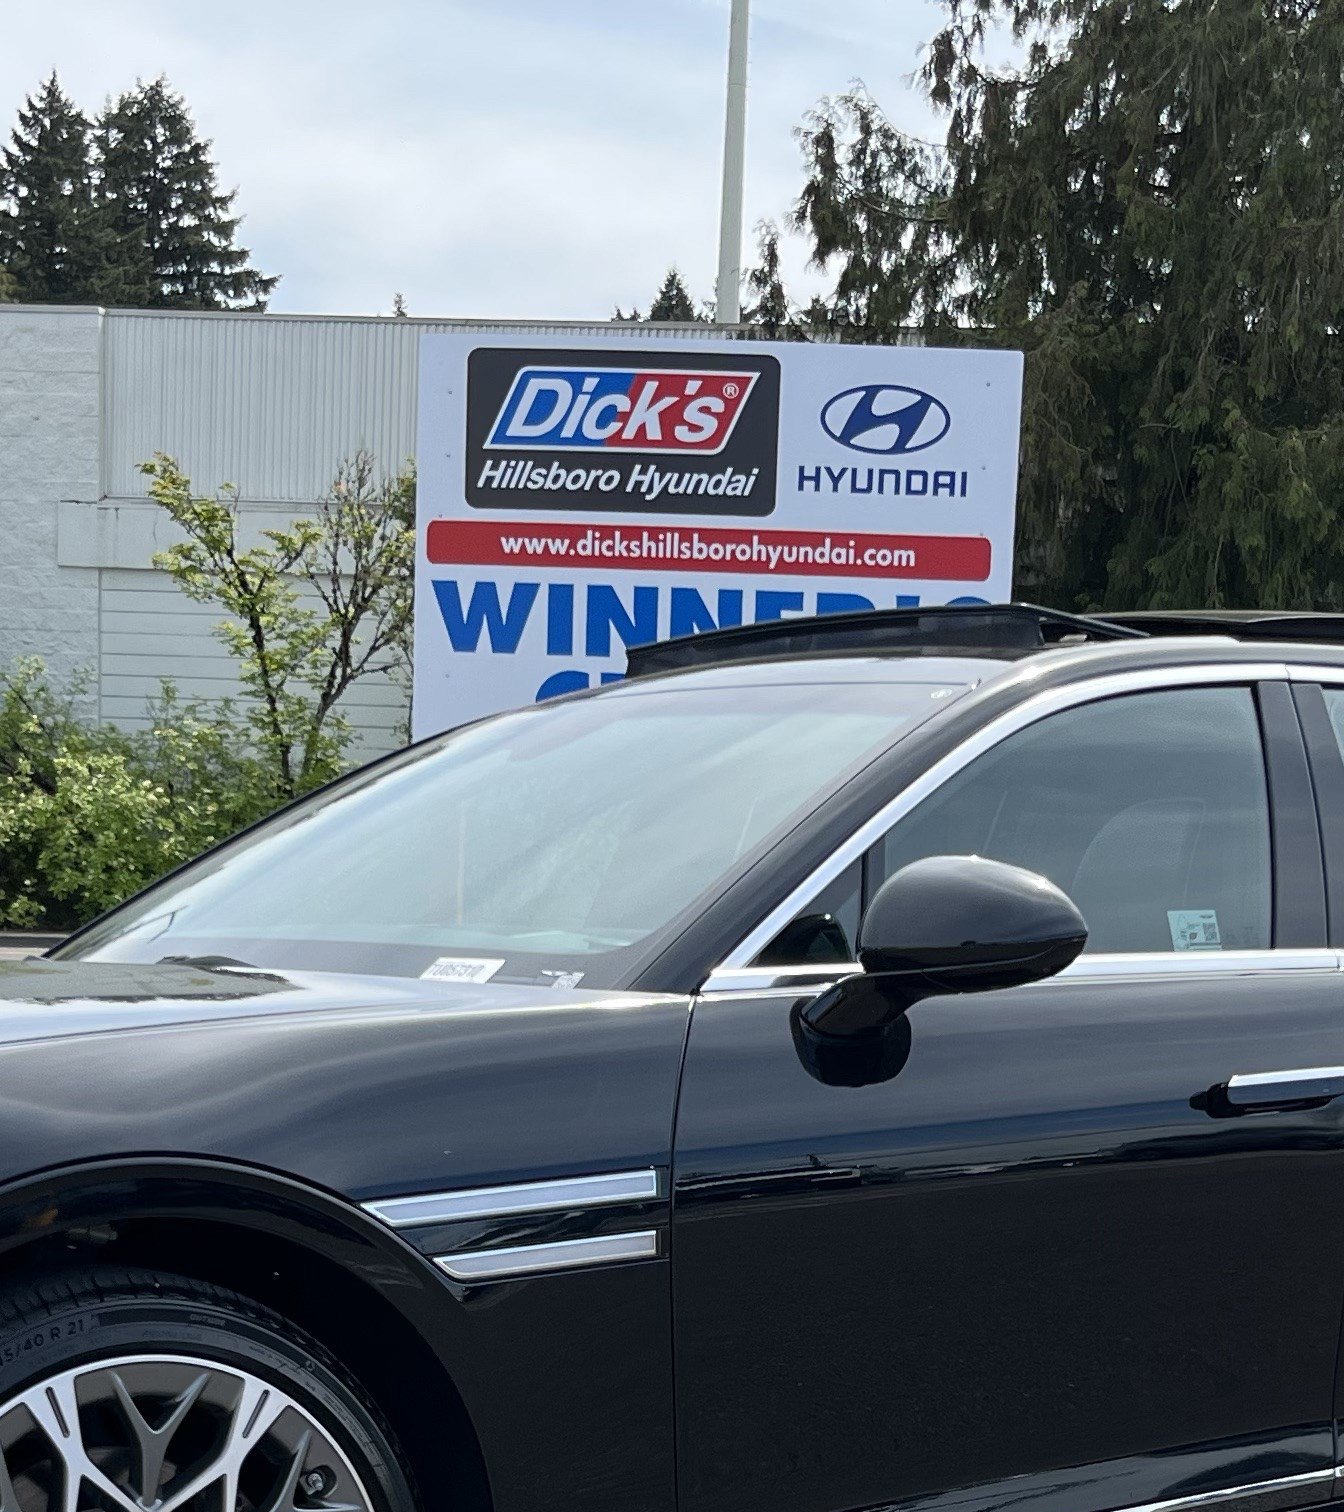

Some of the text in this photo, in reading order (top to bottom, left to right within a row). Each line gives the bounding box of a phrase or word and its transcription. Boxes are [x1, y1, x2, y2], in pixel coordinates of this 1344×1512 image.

[476, 459, 759, 501] Hillsboro Hyundai
[797, 465, 968, 498] HYUNDAI
[500, 530, 916, 570] www.dickshillsborohyundai.com
[67, 1319, 85, 1336] 21
